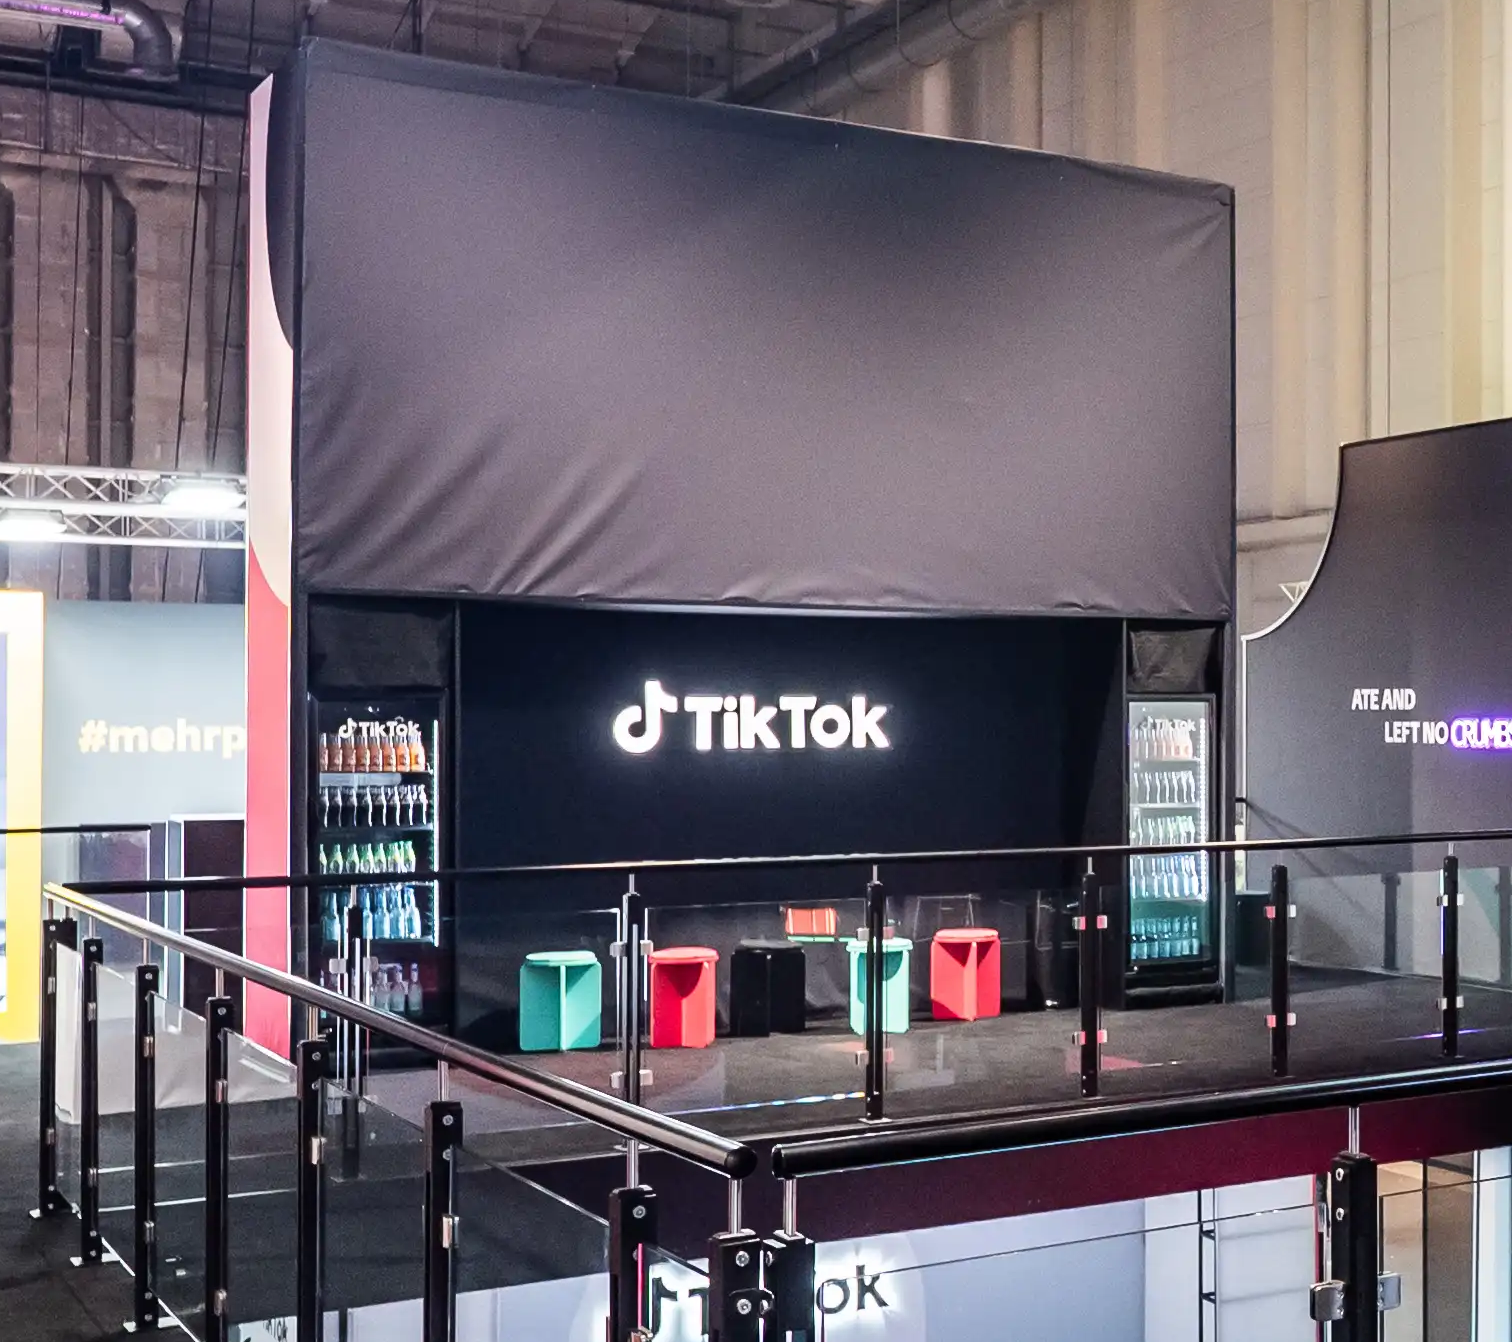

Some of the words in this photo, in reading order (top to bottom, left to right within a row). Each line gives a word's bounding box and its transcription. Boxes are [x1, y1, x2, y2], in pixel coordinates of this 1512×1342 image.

[1351, 688, 1380, 711] ATE
[1381, 688, 1417, 711] AND
[358, 720, 422, 739] TikTok
[684, 695, 891, 751] TikTok
[1384, 721, 1421, 744] LEFT
[1422, 720, 1449, 745] NO
